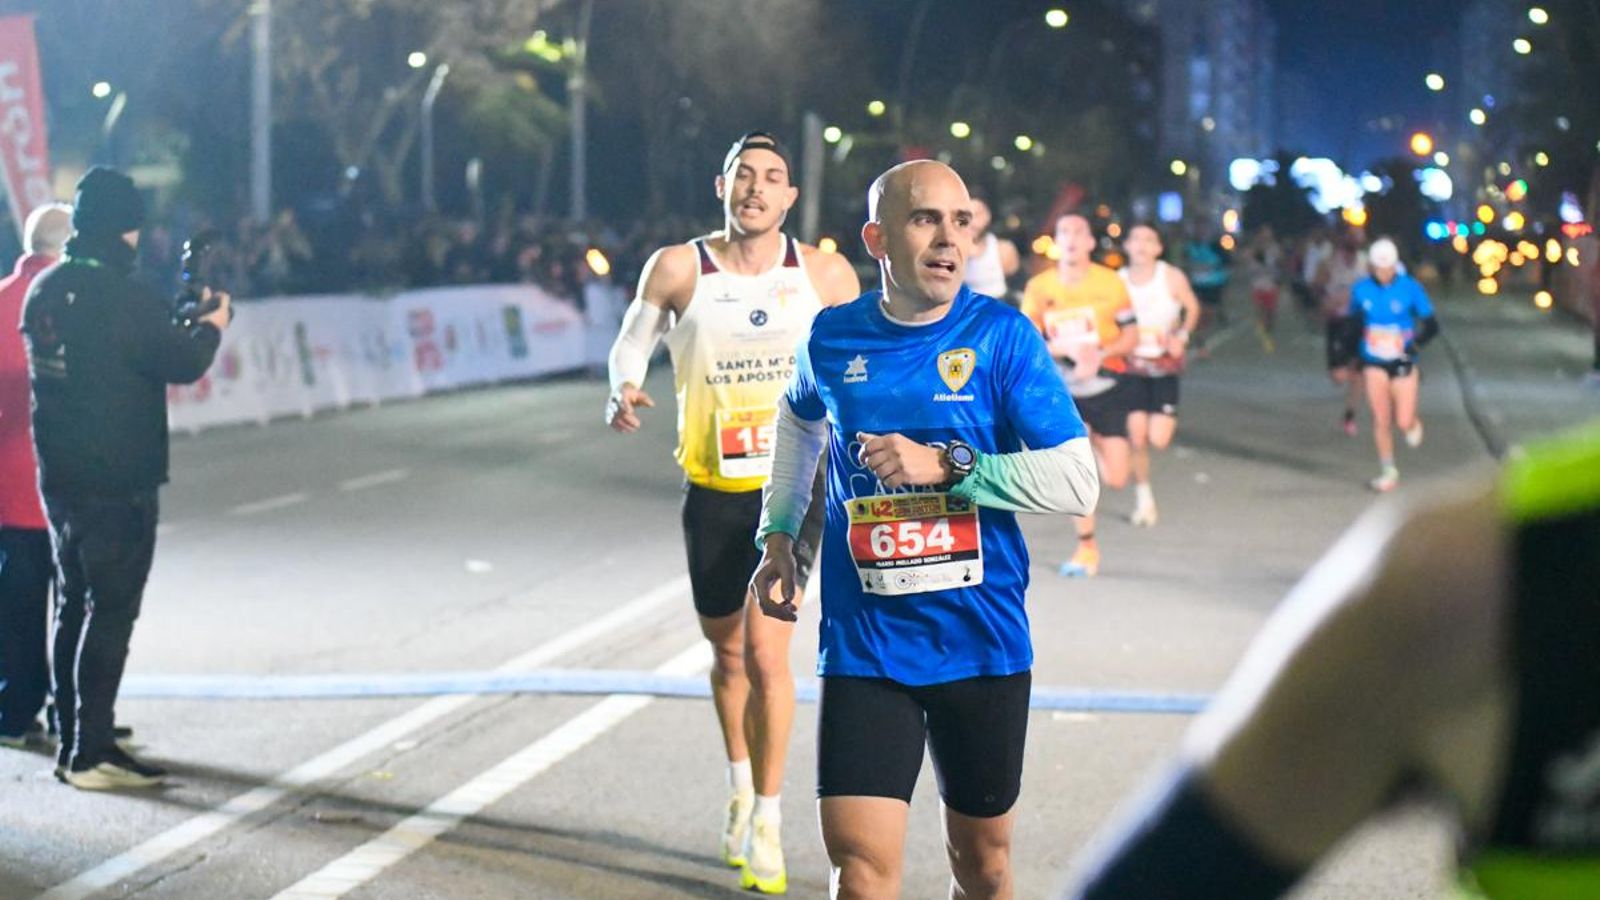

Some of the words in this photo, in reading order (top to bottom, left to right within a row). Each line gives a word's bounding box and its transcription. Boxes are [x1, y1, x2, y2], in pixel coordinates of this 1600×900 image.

[716, 359, 763, 371] SANTA
[705, 374, 732, 385] LOS
[870, 518, 955, 558] 654
